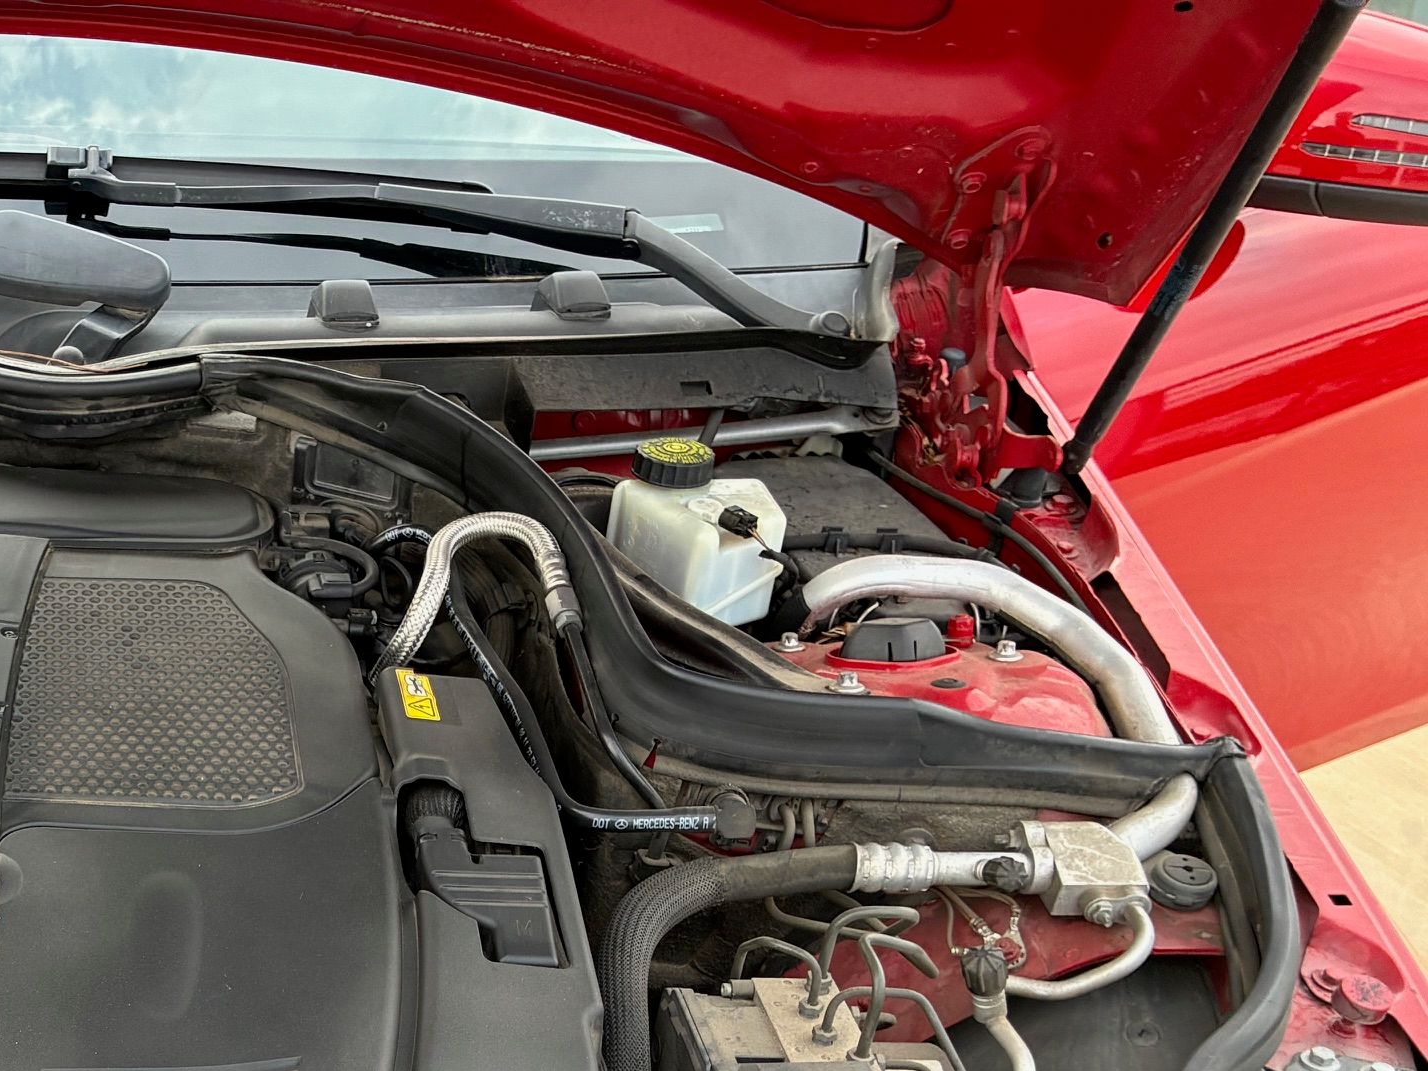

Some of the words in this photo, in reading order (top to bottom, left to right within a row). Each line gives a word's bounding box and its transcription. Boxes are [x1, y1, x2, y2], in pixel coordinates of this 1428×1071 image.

[592, 818, 610, 828] DOT
[632, 817, 699, 830] MERCEDES-BENZ
[703, 817, 709, 829] A
